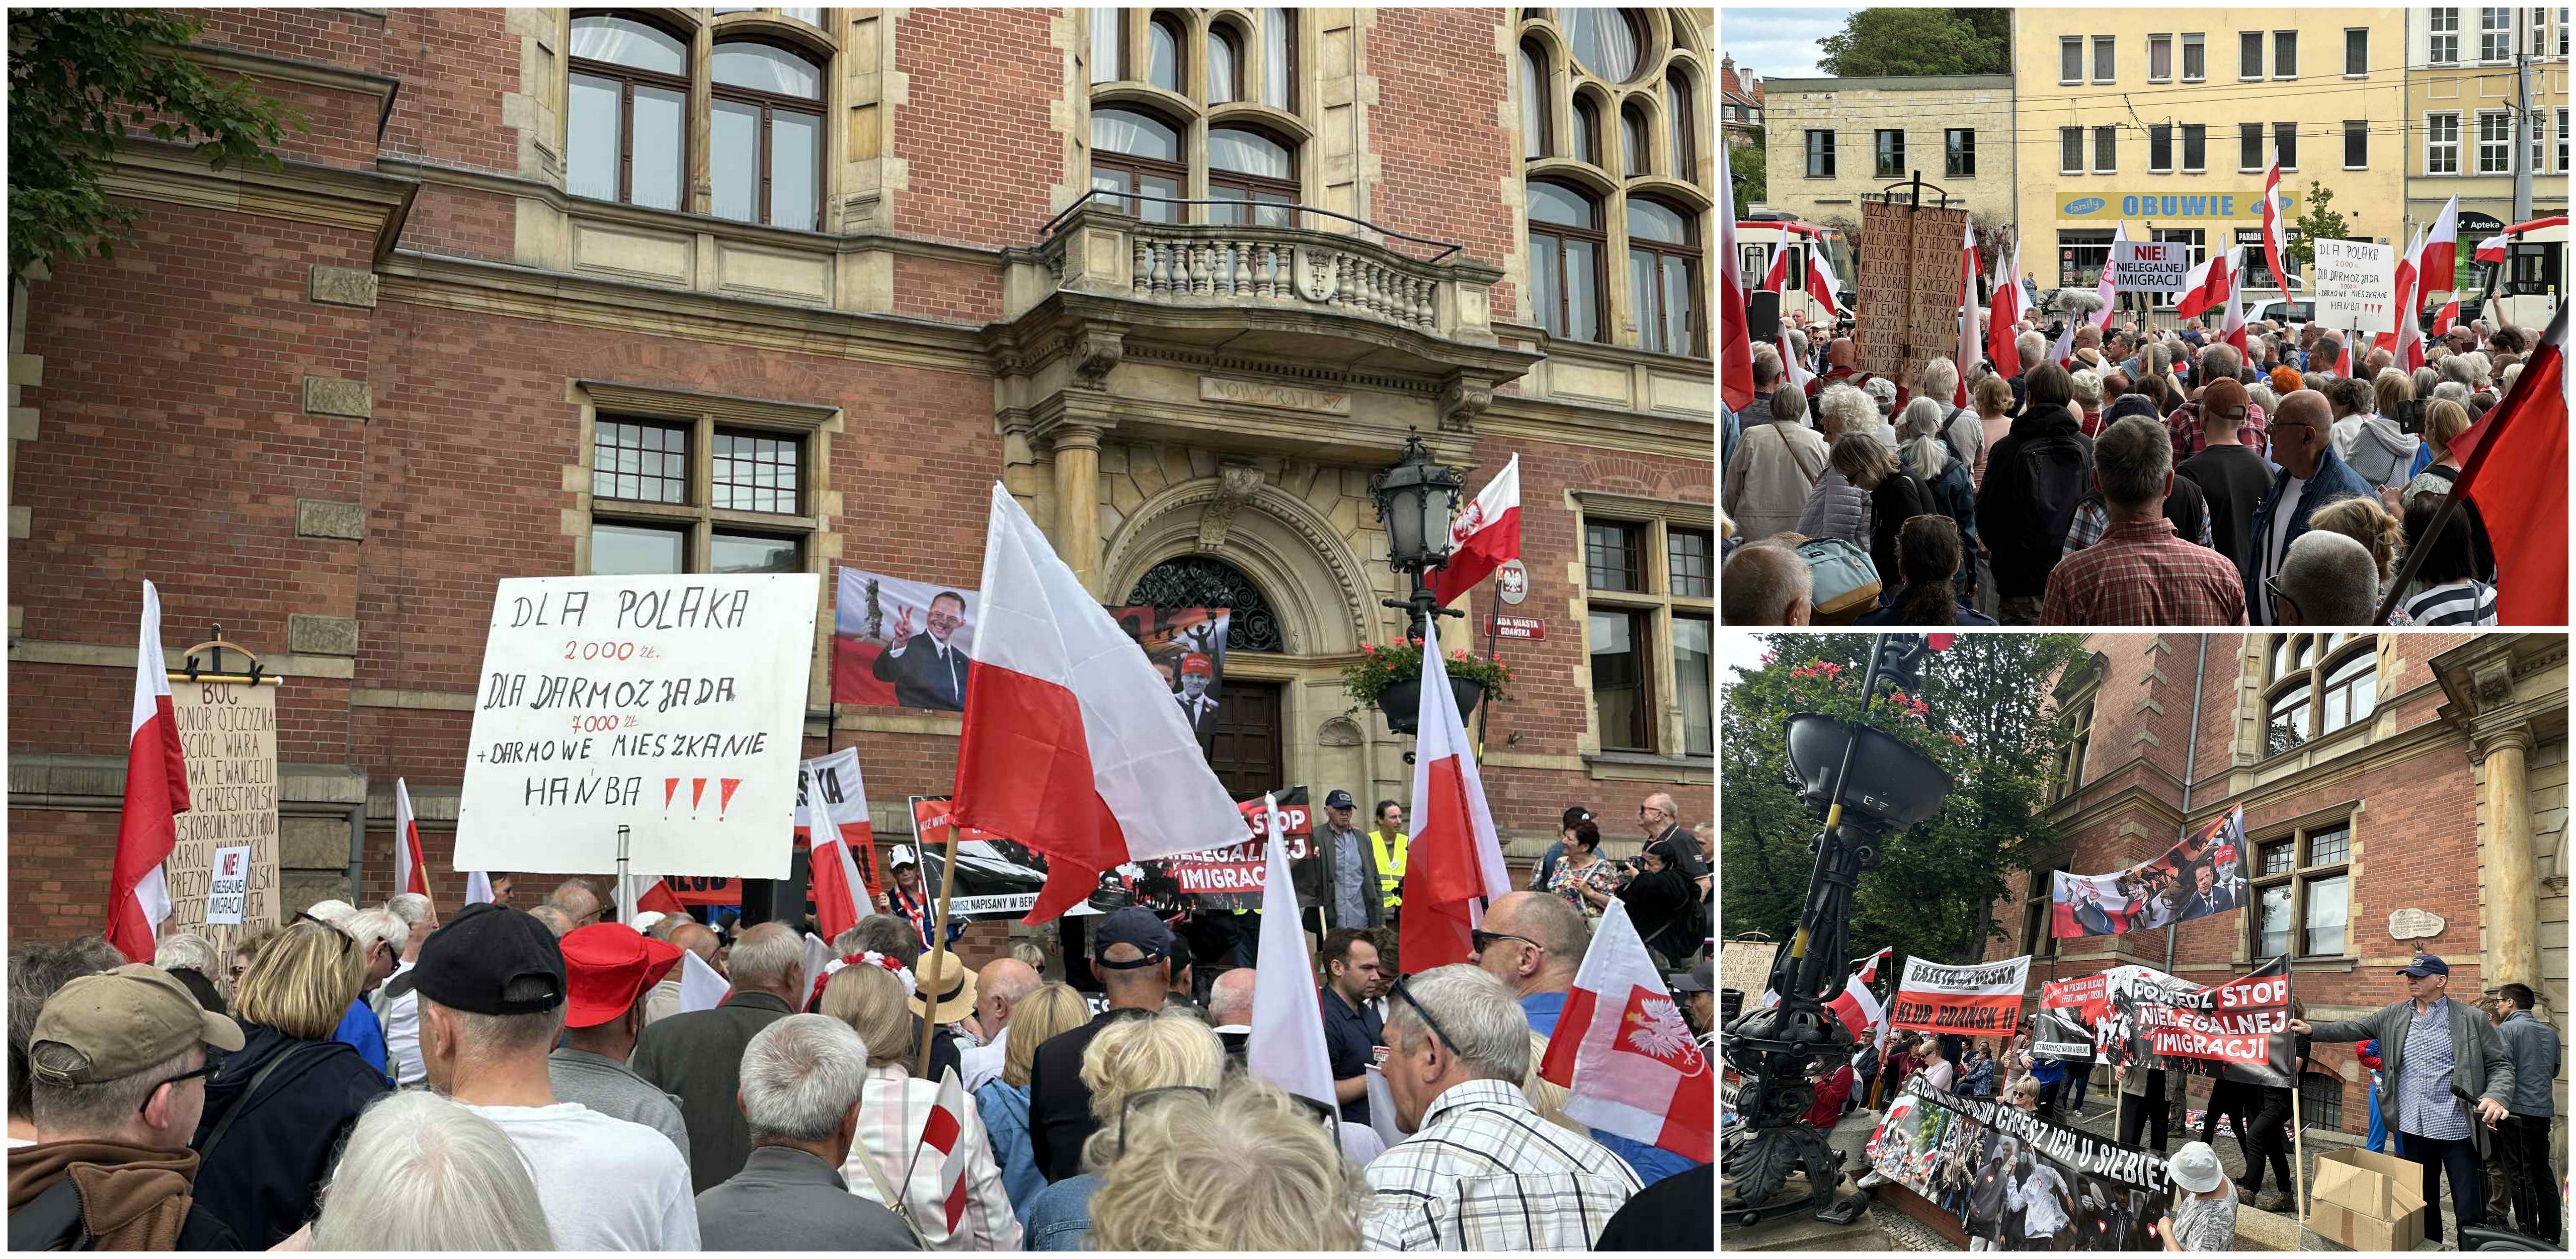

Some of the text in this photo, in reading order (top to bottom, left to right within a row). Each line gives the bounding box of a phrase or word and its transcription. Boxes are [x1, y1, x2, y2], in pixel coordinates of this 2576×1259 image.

[1865, 203, 1891, 218] JEZUS
[1895, 205, 1938, 222] CHRSTUS
[2070, 199, 2099, 213] family
[2123, 196, 2234, 216] OBUWIE
[2257, 200, 2286, 213] fay
[1865, 218, 1875, 231] TO
[2471, 221, 2500, 229] Apteka
[1919, 236, 1965, 251] DZIEDZICTWO
[2239, 233, 2262, 241] PARADA
[1864, 246, 1958, 266] POLSKA TWJA MATKA
[2135, 245, 2166, 261] NIE!
[2319, 243, 2378, 261] DLA POLAKA
[1862, 261, 1871, 274] NIE
[2117, 263, 2184, 273] NIELEGALNEJ
[2317, 268, 2327, 280] DLA
[1881, 276, 1909, 289] DOBRE
[2119, 274, 2182, 286] IMIGRACJI
[1917, 292, 1957, 308] SUWERENNA
[2352, 291, 2387, 299] MIESZKANIE
[1859, 302, 1955, 321] NIE LEWACA POLSKA
[1858, 317, 1897, 331] PORASZKA
[1870, 331, 1903, 345] DOMKNIE
[1891, 346, 1929, 360] SZDNICY
[1214, 381, 1343, 410] NOWY RATUSZ
[511, 586, 749, 629] DLA POLAKA
[1496, 618, 1539, 629] ADA MIASTA
[565, 641, 634, 661] 2000
[484, 672, 526, 710] DLA
[176, 706, 274, 731] ONOR OJCZYZNA
[572, 715, 619, 734] 7000
[224, 734, 260, 758] WIARA
[612, 733, 768, 759] MIESZKANIE
[197, 787, 244, 812] CHRZEST
[246, 786, 277, 811] POLSKI
[190, 814, 227, 841] KORONA
[231, 813, 259, 838] POLSKI
[222, 854, 239, 876] NIE!
[171, 864, 275, 898] PREZYD OLSKI
[1181, 866, 1266, 889] IMIGRAC
[971, 896, 1007, 910] NAPISANY
[1010, 897, 1017, 908] W
[1748, 951, 1775, 959] OJCZYZNA
[1729, 973, 1751, 981] CHRZEST
[1752, 974, 1769, 982] POLSKI
[1911, 965, 2016, 985] GAZETA POLSKA
[1724, 981, 1740, 989] KORONA
[1741, 982, 1756, 990] POLSKI
[2069, 981, 2086, 992] POLSKICH
[2087, 978, 2105, 989] ULICACH
[2222, 980, 2286, 1006] STOP
[1743, 998, 1760, 1006] POLSKI
[2061, 994, 2073, 1003] EFEKT
[2090, 989, 2103, 1000] TUSKA
[1895, 1000, 2016, 1029] KLUB GDAŃSK II
[2140, 1007, 2286, 1035] NIELEGALNEJ
[2036, 1043, 2061, 1052] SCENARIUSZ
[2156, 1033, 2264, 1059] IMIGRACJI
[1961, 1098, 1995, 1125] POLSKA
[2046, 1127, 2076, 1162] ICH
[2078, 1138, 2093, 1167] U
[2094, 1144, 2171, 1195] SIEBIE?
